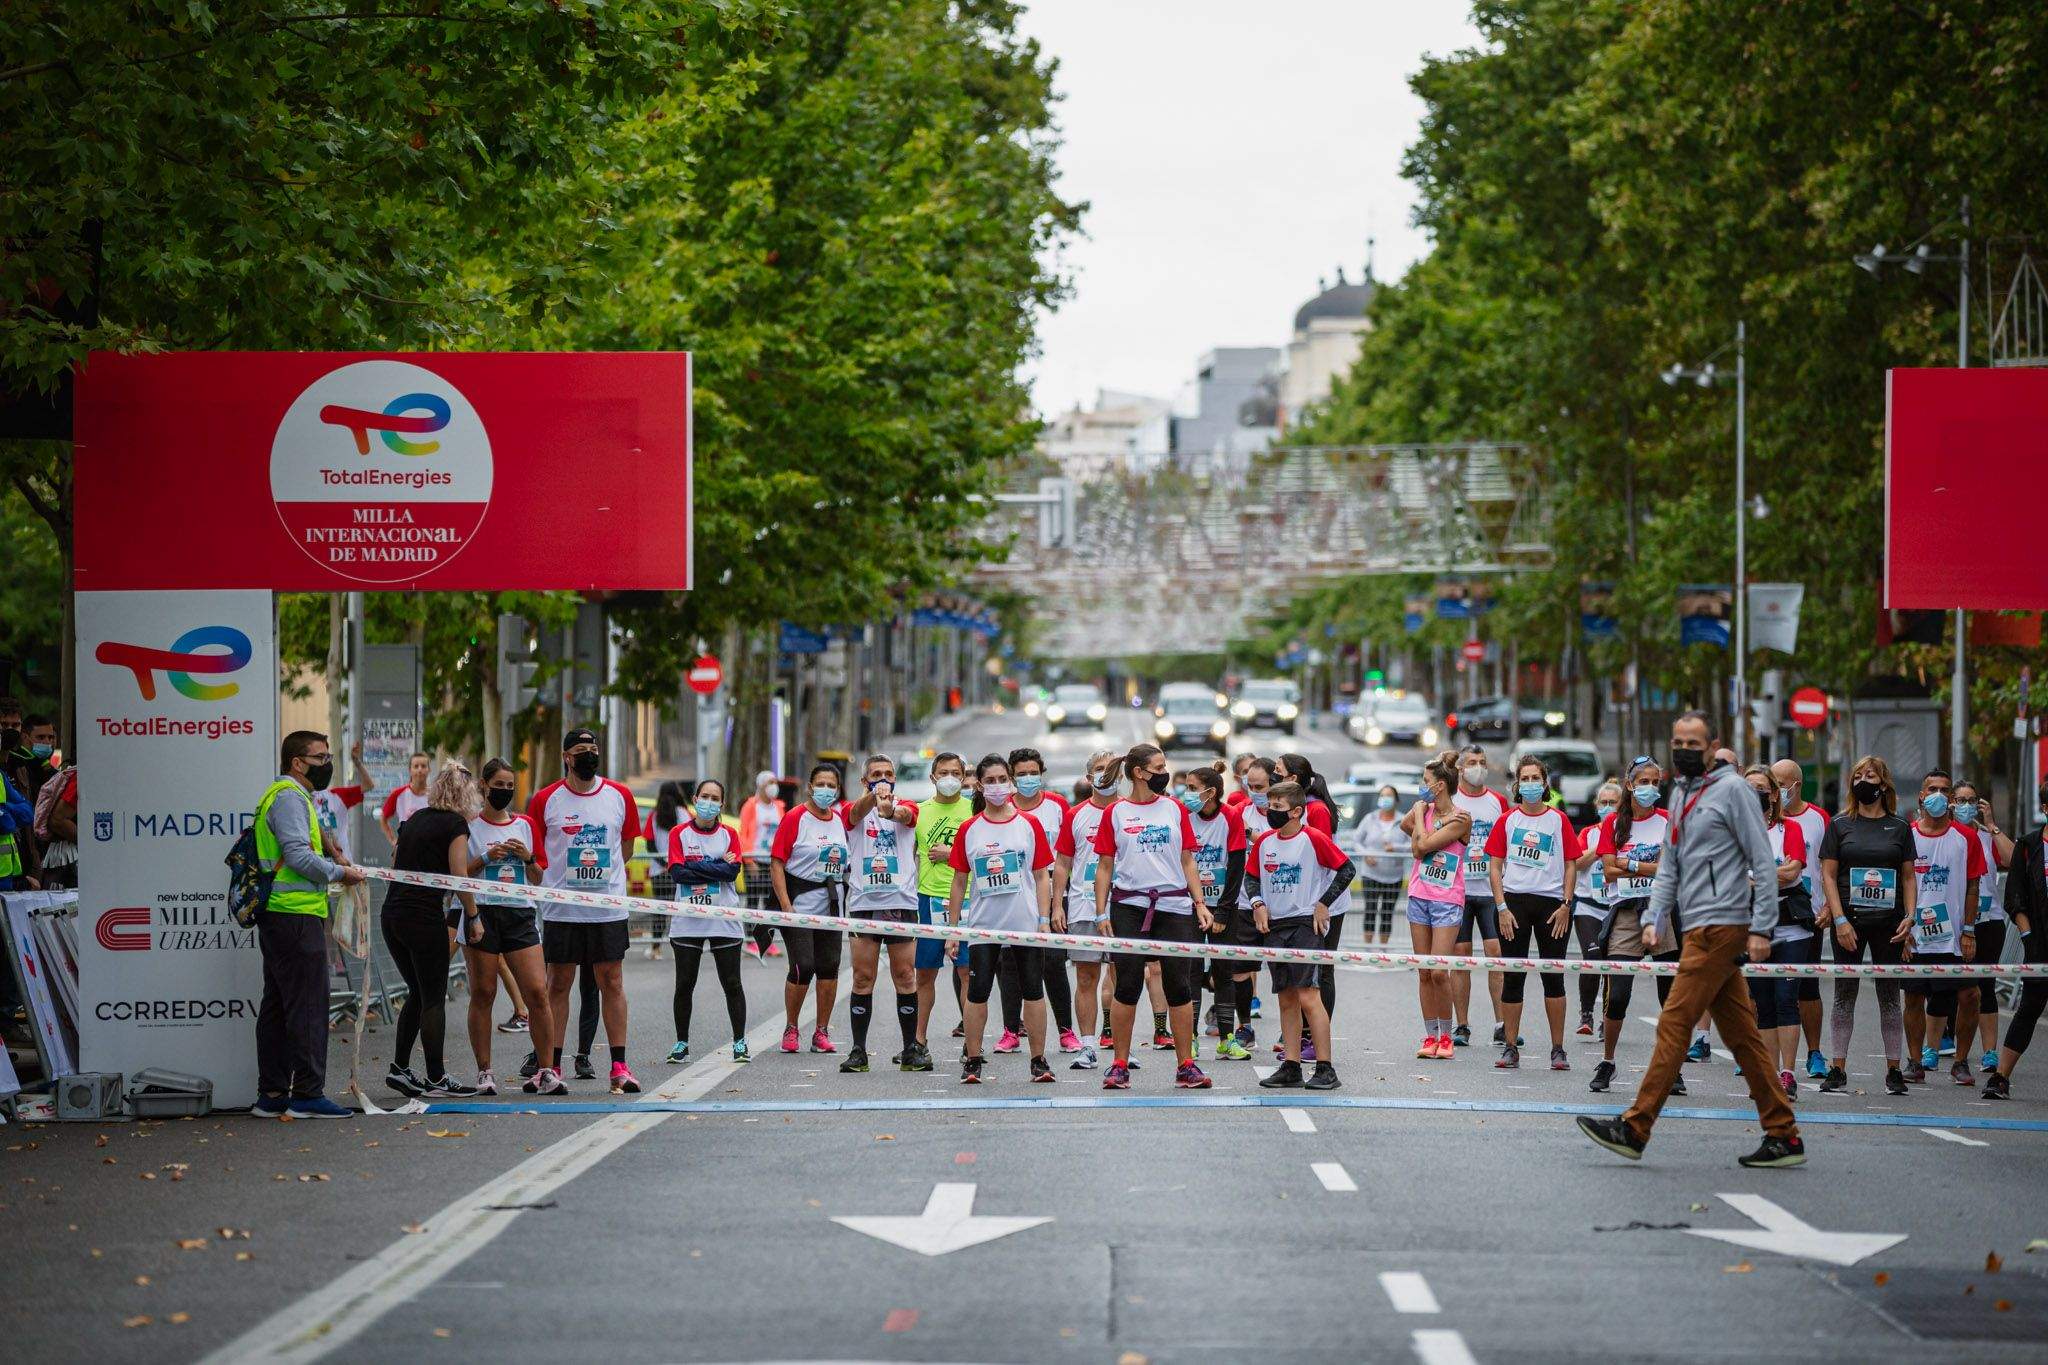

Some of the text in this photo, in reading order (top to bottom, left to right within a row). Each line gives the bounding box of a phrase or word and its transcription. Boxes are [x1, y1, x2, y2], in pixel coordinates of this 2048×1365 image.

[320, 469, 451, 488] TotalEnergies
[353, 508, 414, 523] MILLA
[329, 548, 437, 562] DE MADRID
[96, 716, 254, 740] TotalEnergies
[1517, 846, 1540, 861] 1140
[575, 867, 603, 880] 1002
[824, 862, 841, 874] 1129
[1424, 864, 1448, 881] 1089
[1467, 861, 1487, 873] 1119
[869, 873, 892, 885] 1148
[986, 873, 1010, 888] 1118
[157, 892, 225, 902] new balance
[689, 894, 712, 906] 1126
[1859, 887, 1886, 900] 1081
[159, 907, 232, 926] MILL
[1922, 924, 1943, 937] 1141
[159, 930, 257, 950] URBANA
